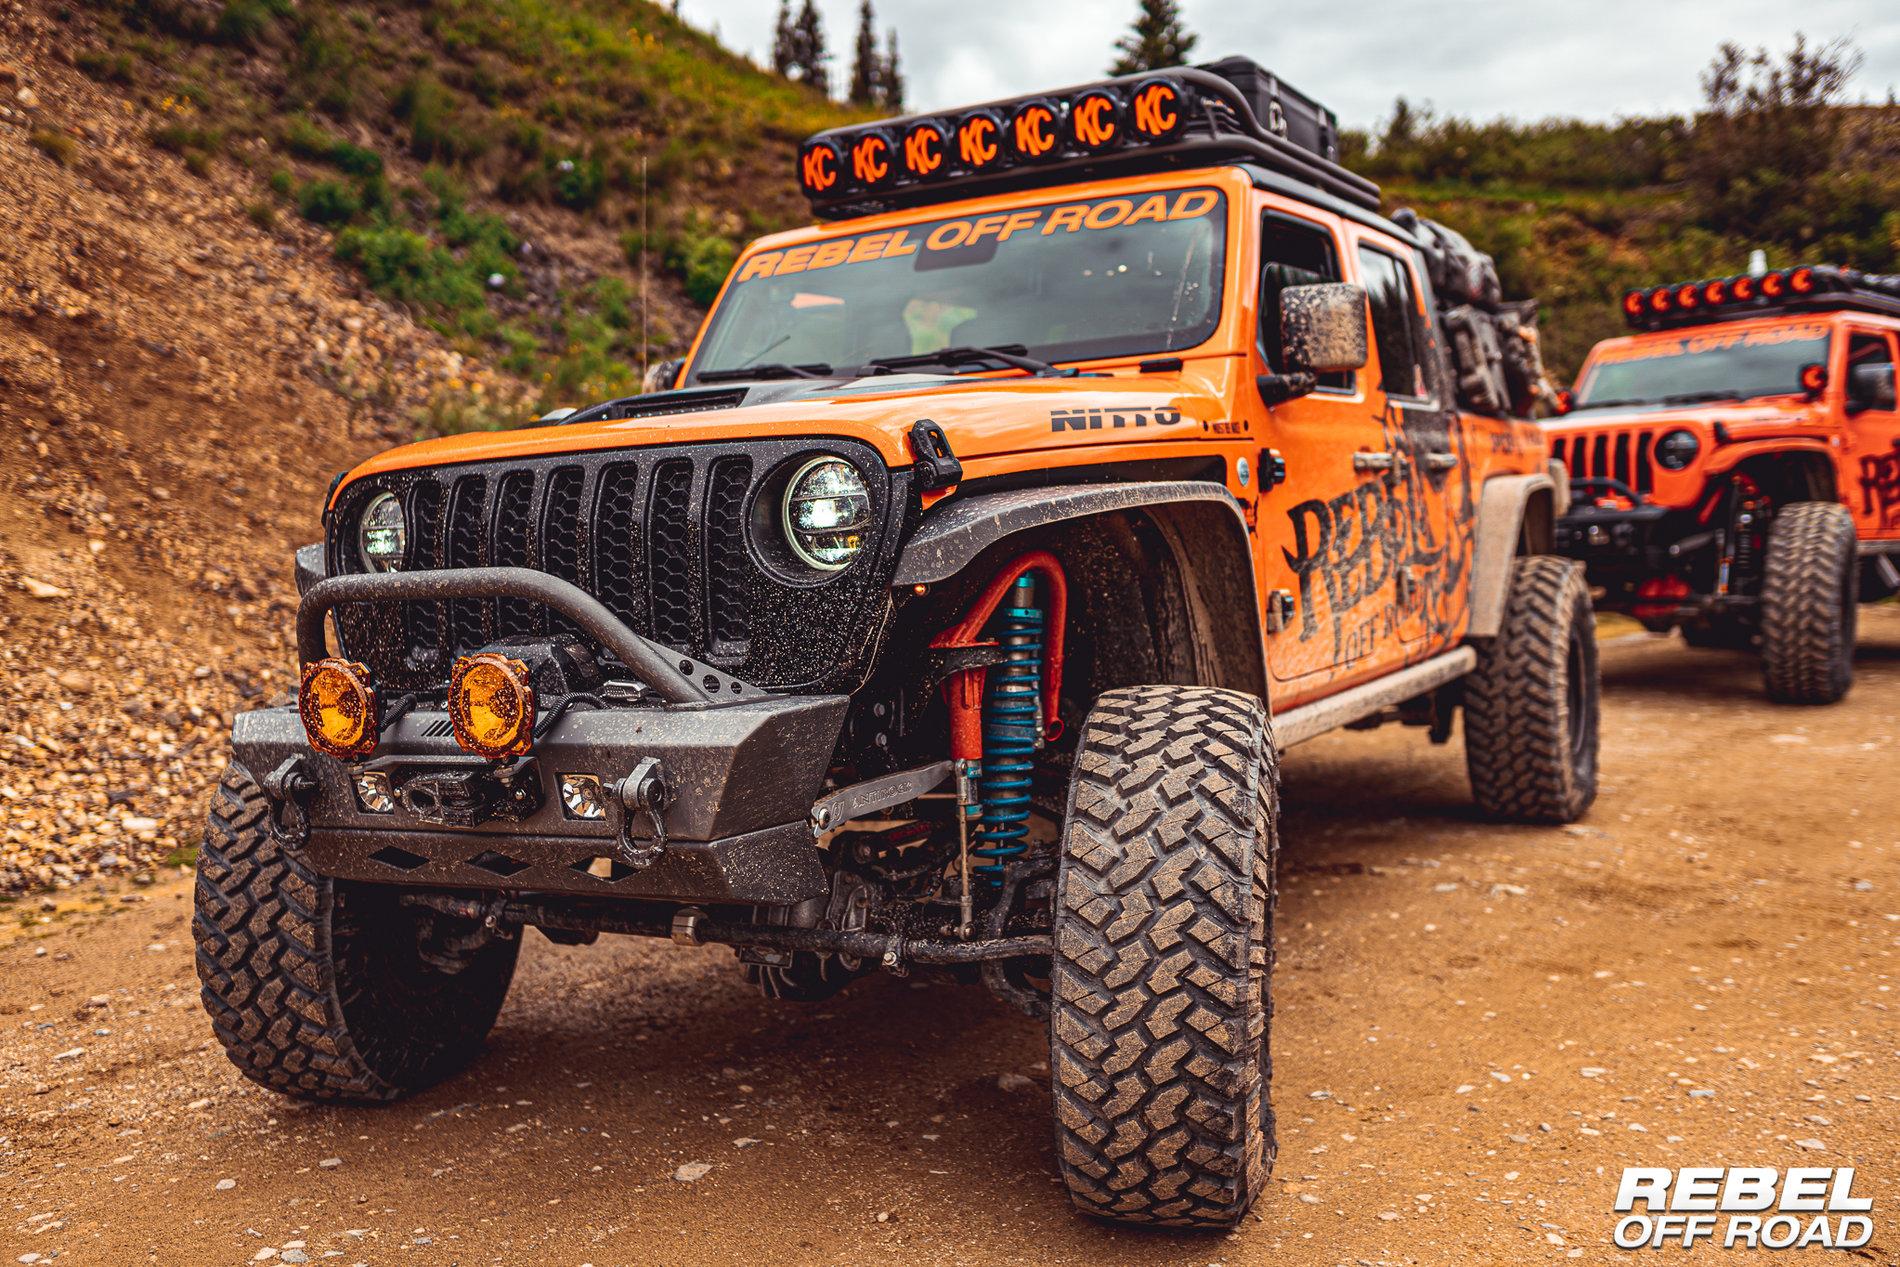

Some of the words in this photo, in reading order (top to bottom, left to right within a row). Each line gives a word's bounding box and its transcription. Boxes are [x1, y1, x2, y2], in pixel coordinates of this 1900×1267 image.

[803, 147, 836, 190] KC
[853, 138, 888, 183] KC
[906, 126, 942, 174] KC
[960, 118, 997, 165] KC
[1016, 107, 1054, 155] KC
[1075, 97, 1115, 145] KC
[1136, 86, 1176, 135] KC
[737, 230, 919, 283] REBEL
[927, 210, 1038, 251] OFF
[1042, 190, 1220, 236] ROAD
[1050, 406, 1181, 432] NITTO
